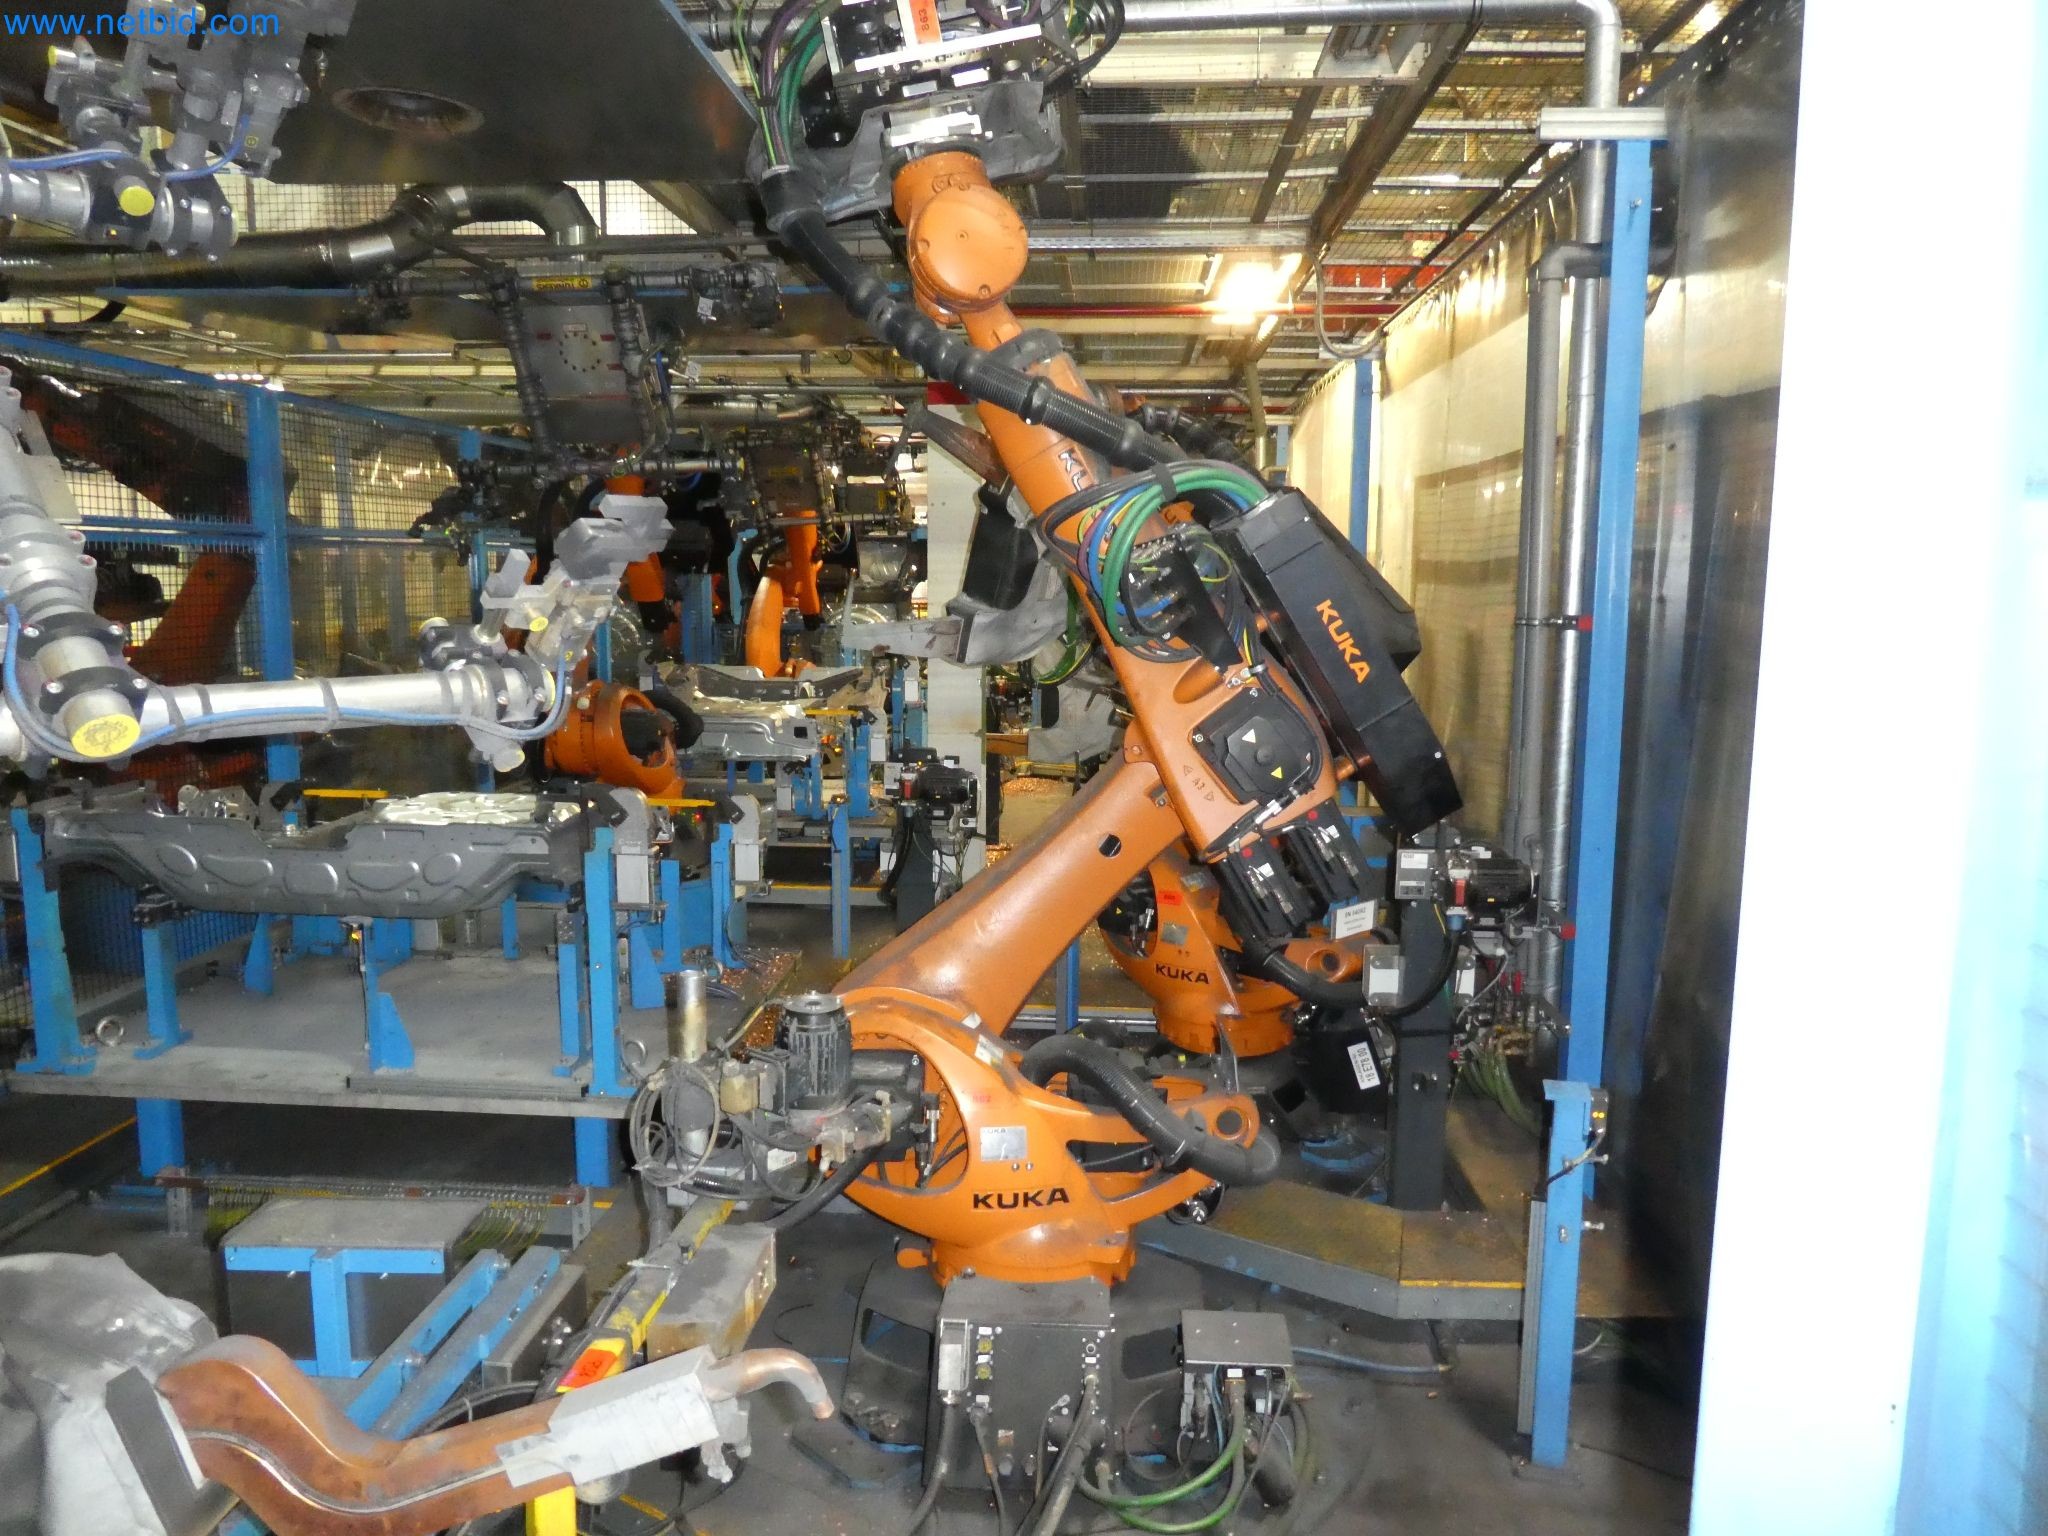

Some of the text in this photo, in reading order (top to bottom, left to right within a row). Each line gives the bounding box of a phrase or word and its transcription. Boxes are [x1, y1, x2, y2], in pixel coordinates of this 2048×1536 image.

[1315, 599, 1371, 684] KUKA
[1155, 963, 1210, 985] KUKA
[973, 1187, 1071, 1210] KUKA
